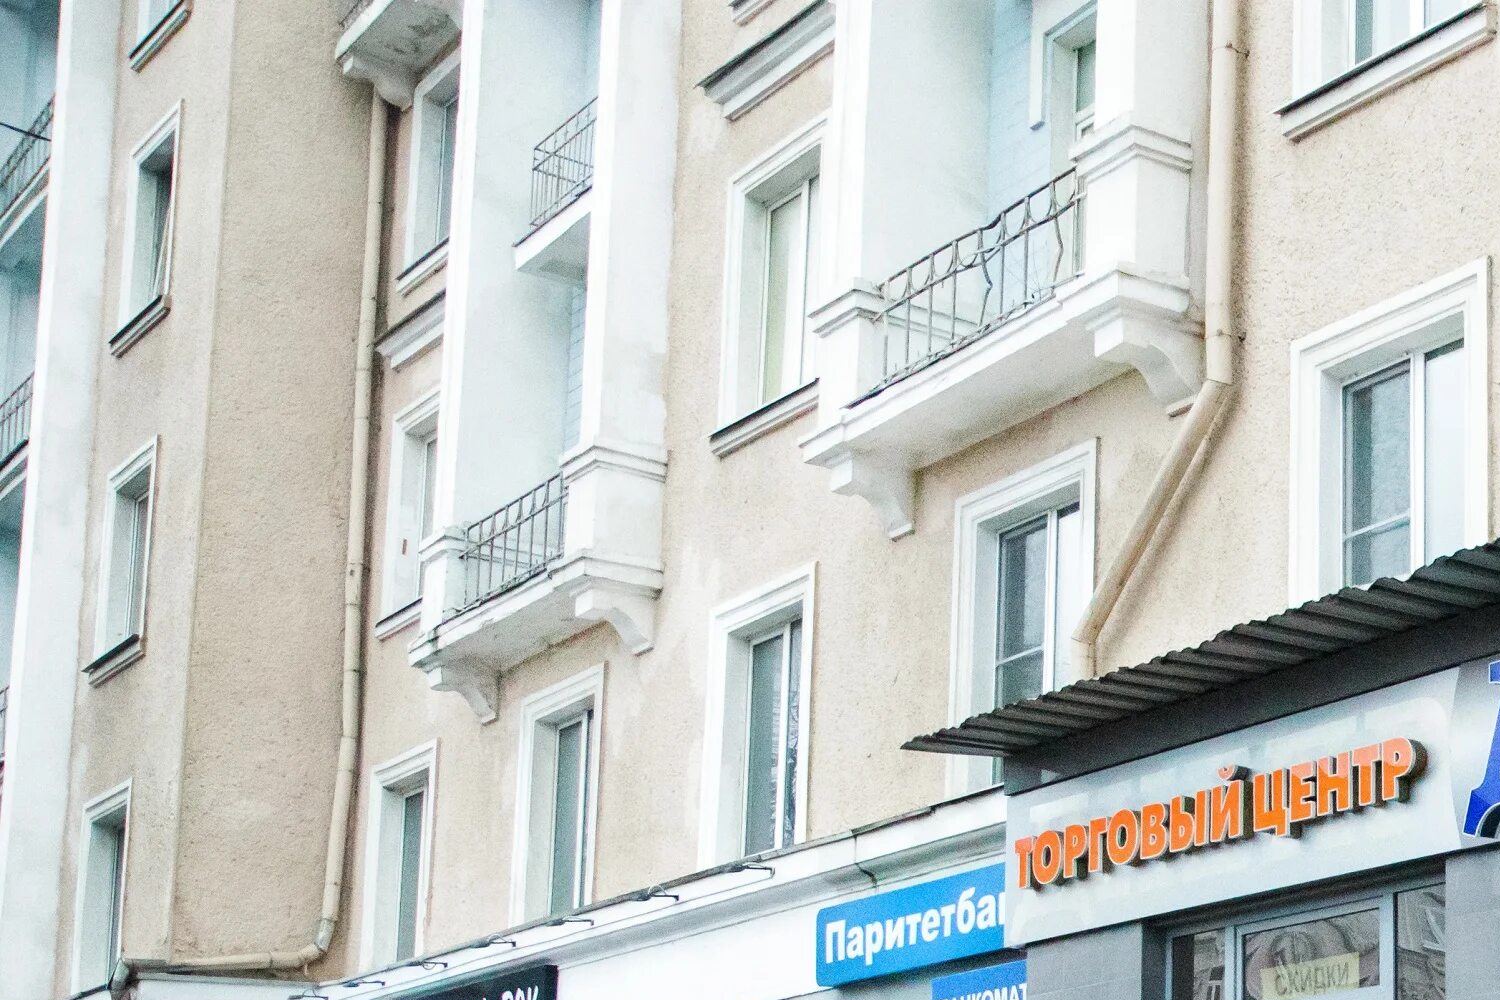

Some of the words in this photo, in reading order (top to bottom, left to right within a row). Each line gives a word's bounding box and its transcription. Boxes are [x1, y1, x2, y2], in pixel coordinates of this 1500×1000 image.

[1014, 764, 1247, 890] ТОРГОВЫЙ
[1252, 737, 1420, 838] ЦЕНТР
[1275, 962, 1349, 996] СКИДКИ
